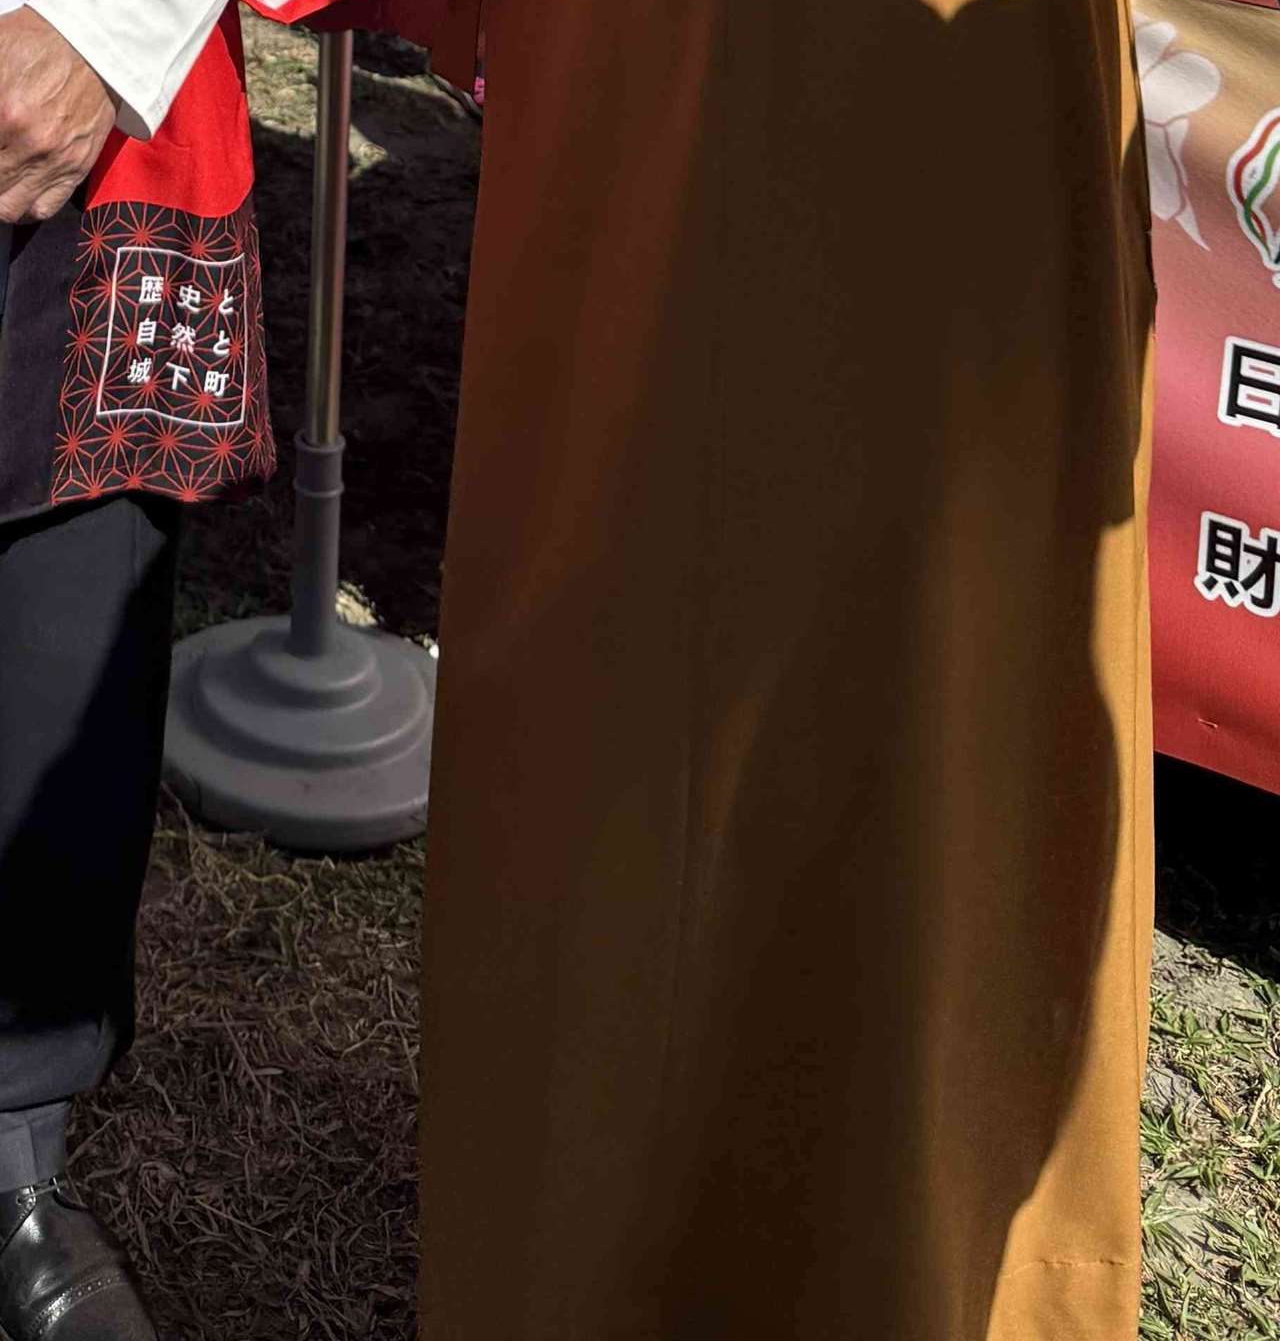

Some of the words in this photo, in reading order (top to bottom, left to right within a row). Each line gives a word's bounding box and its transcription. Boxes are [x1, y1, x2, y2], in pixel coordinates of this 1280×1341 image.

[138, 275, 234, 316] 歴史と
[136, 317, 231, 357] 自然と
[127, 357, 229, 398] 城下町
